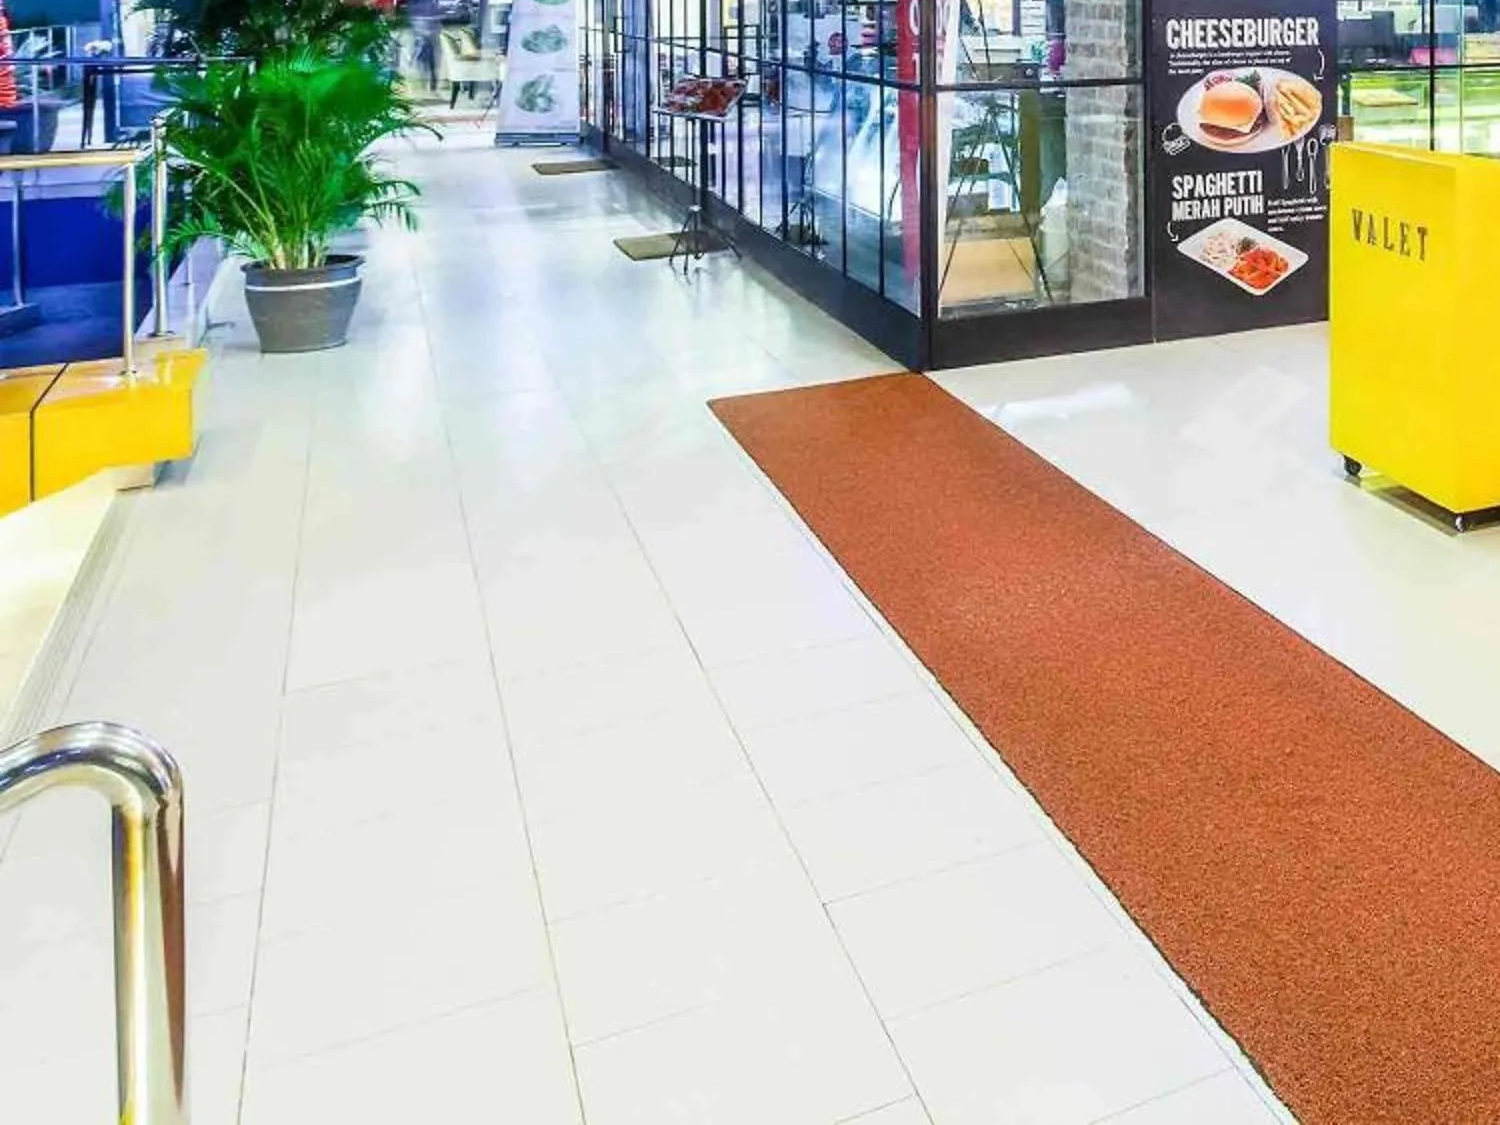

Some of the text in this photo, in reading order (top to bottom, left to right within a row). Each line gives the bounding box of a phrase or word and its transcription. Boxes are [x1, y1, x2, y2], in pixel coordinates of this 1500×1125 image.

[1166, 17, 1319, 49] CHEESEBURGER
[1172, 171, 1262, 199] SPAGHETTI
[1172, 198, 1221, 221] MERAH
[1223, 195, 1264, 216] PUTIH
[1352, 209, 1429, 261] VALET
